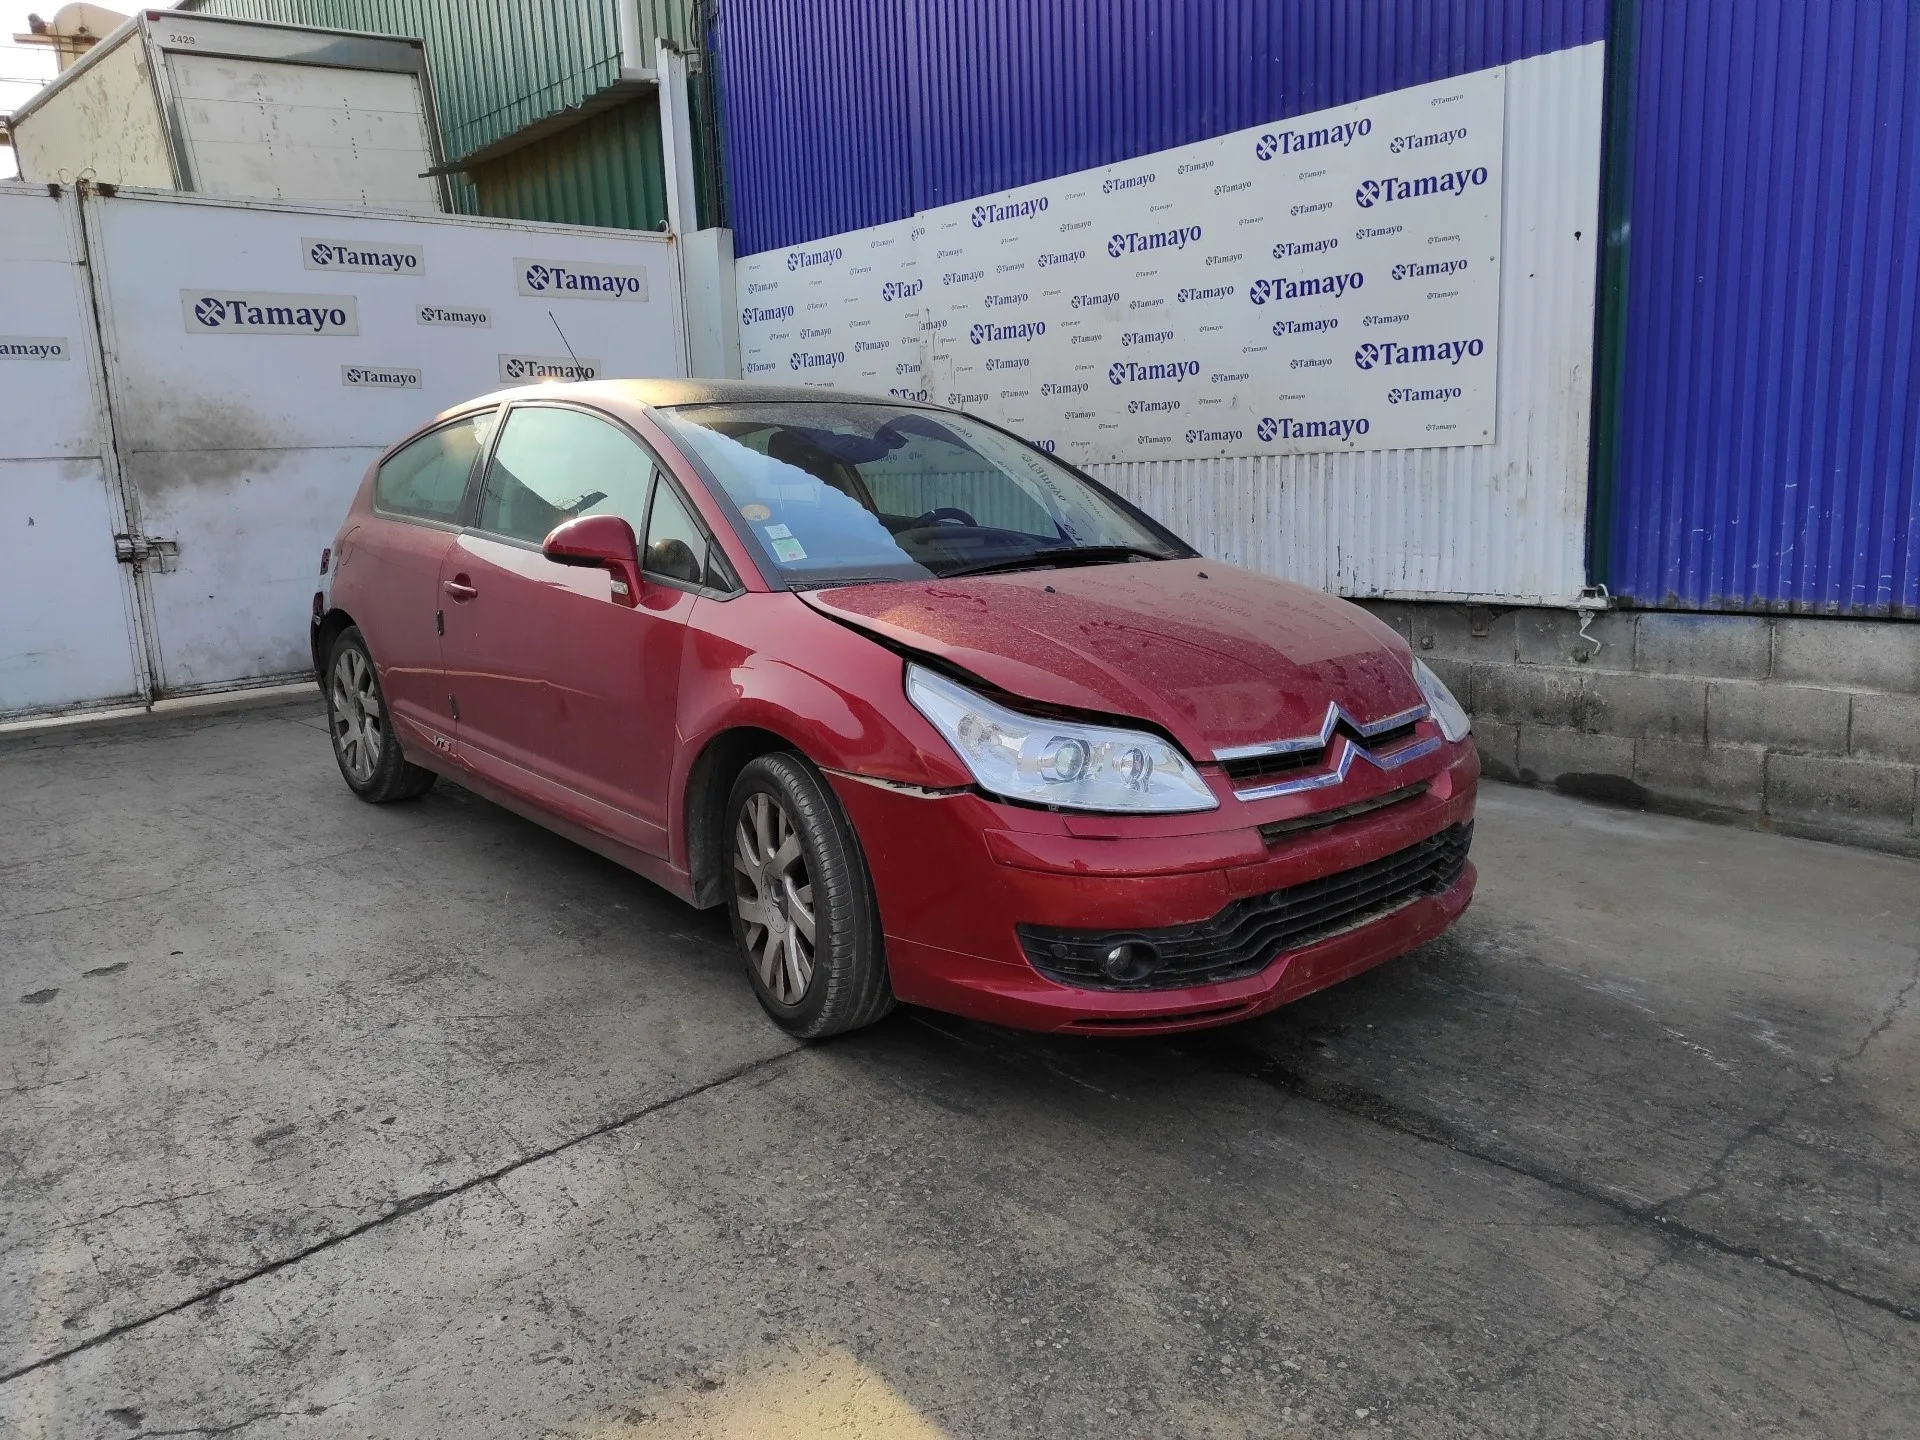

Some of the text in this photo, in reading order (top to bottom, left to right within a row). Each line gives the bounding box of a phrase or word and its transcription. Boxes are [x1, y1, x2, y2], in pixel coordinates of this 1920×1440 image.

[169, 34, 195, 44] 2429
[1438, 94, 1463, 104] Tamayo
[1279, 118, 1371, 154] Tamayo
[1405, 128, 1467, 149] Tamayo
[1185, 160, 1214, 173] Tamayo
[1113, 173, 1155, 191] Tamayo
[1221, 181, 1251, 194] Tamayo
[1381, 167, 1487, 203] Tamayo
[987, 197, 1048, 222] Tamayo
[1299, 201, 1333, 214] Tamayo
[1066, 220, 1092, 231] Tamayo
[1365, 225, 1402, 238] Tamayo
[1126, 225, 1201, 253] Tamayo
[1286, 238, 1338, 256] Tamayo
[333, 246, 417, 271] Tamayo
[798, 247, 842, 268] Tamayo
[1048, 250, 1085, 266] Tamayo
[1213, 253, 1242, 264] Tamayo
[1002, 262, 1024, 273] Tamayo
[1407, 259, 1467, 277] Tamayo
[550, 268, 640, 297] Tamayo
[951, 270, 984, 283] Tamayo
[754, 281, 778, 293] Tamayo
[1272, 271, 1363, 300] Tamayo
[992, 293, 1028, 307] Tamayo
[1081, 292, 1120, 307] Tamayo
[1189, 286, 1234, 301] Tamayo
[1434, 290, 1458, 299] Tamayo
[1136, 298, 1164, 309] Tamayo
[226, 300, 347, 332] Tamayo
[435, 309, 487, 325] Tamayo
[752, 304, 794, 323] Tamayo
[1372, 313, 1409, 325] Tamayo
[985, 321, 1046, 342] Tamayo
[1286, 318, 1338, 333] Tamayo
[807, 327, 831, 339] Tamayo
[1077, 334, 1102, 344] Tamayo
[1132, 330, 1174, 345] Tamayo
[0, 344, 61, 359] amayo
[861, 340, 889, 351] Tamayo
[1381, 338, 1483, 365] Tamayo
[752, 362, 775, 372] Tamayo
[800, 352, 844, 369] Tamayo
[994, 358, 1029, 371] Tamayo
[1299, 358, 1332, 368] Tamayo
[362, 371, 417, 385] Tamayo
[525, 361, 595, 381] Tamayo
[1126, 360, 1200, 382] Tamayo
[1219, 373, 1249, 383] Tamayo
[1007, 389, 1028, 399] Tamayo
[1050, 382, 1088, 396] Tamayo
[1403, 387, 1461, 402] Tamayo
[956, 393, 988, 404] Tamayo
[1140, 401, 1180, 413] Tamayo
[1071, 411, 1095, 419] Tamayo
[1197, 429, 1242, 443] Tamayo
[1279, 417, 1369, 441] Tamayo
[1145, 435, 1171, 445] Tamayo
[434, 735, 450, 751] VTS
